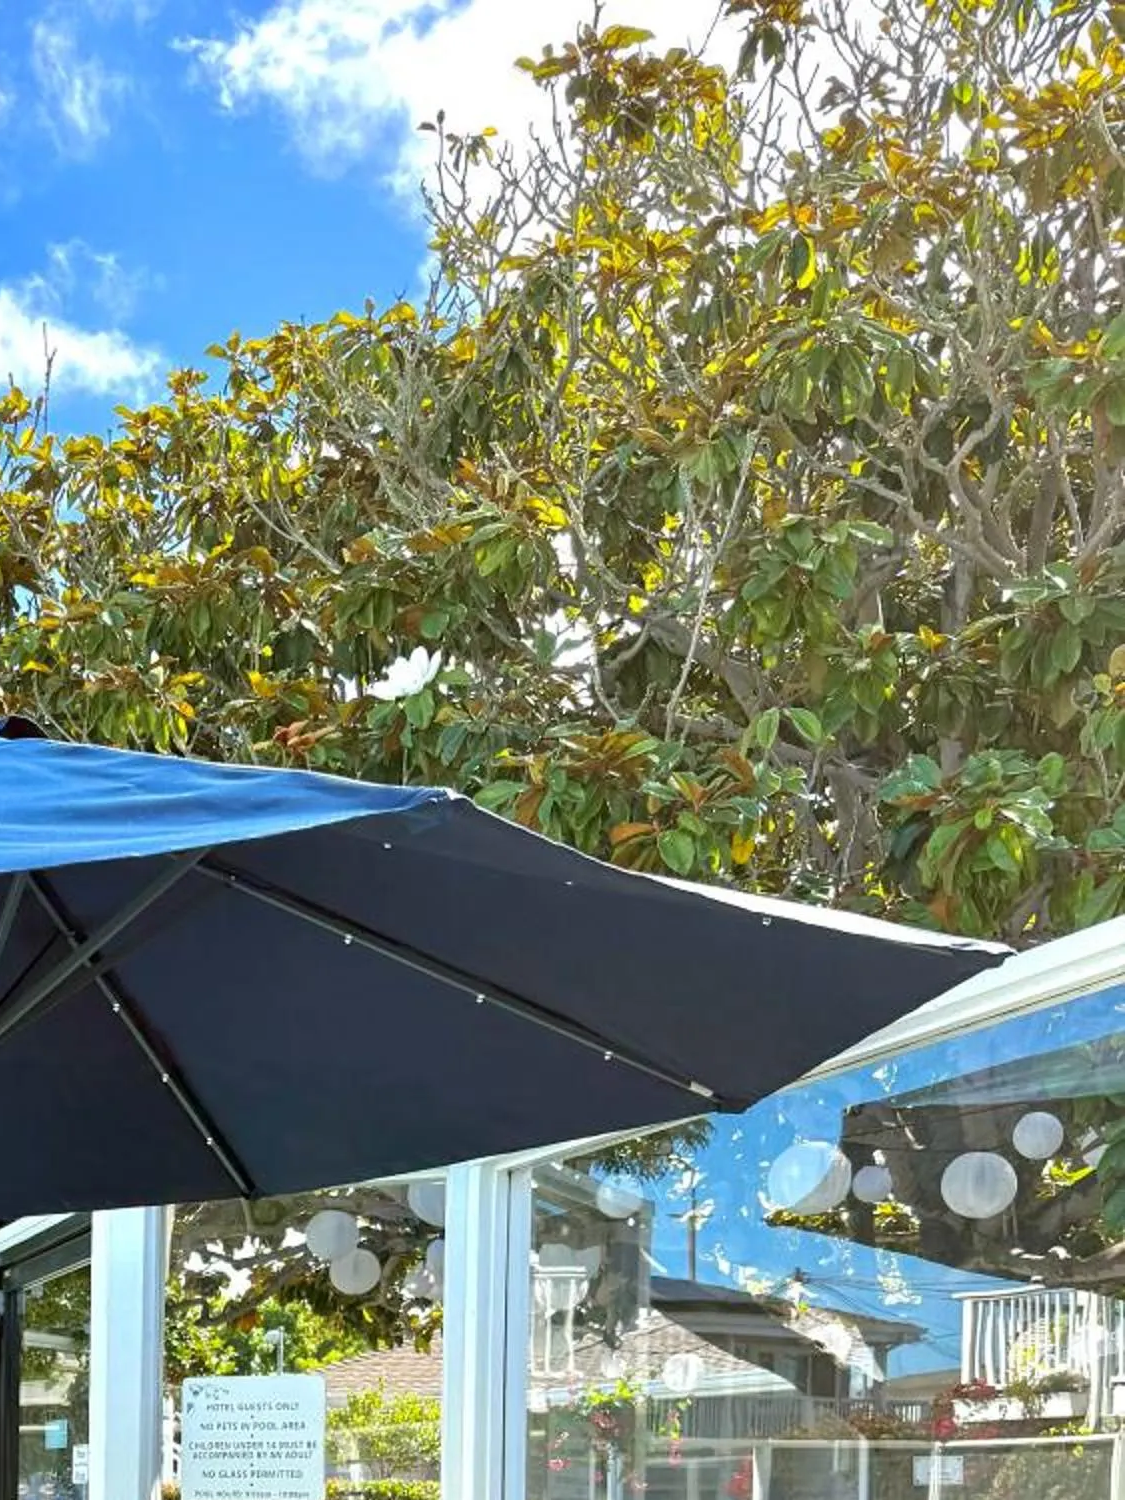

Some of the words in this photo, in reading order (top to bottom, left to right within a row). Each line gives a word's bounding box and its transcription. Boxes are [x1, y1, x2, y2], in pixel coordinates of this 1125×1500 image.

[206, 1402, 235, 1412] HOTEL
[237, 1402, 273, 1412] GUESTS
[276, 1402, 300, 1412] ONLY
[216, 1422, 238, 1431] PETS
[240, 1422, 252, 1431] IN
[253, 1422, 278, 1431] POOL
[281, 1421, 306, 1430] AREA
[188, 1440, 232, 1450] CHILDREN
[306, 1440, 317, 1449] BE
[284, 1450, 313, 1460] ADULT
[202, 1469, 216, 1479] NO
[218, 1469, 248, 1479] GLASS
[250, 1469, 304, 1479] PERMITTED
